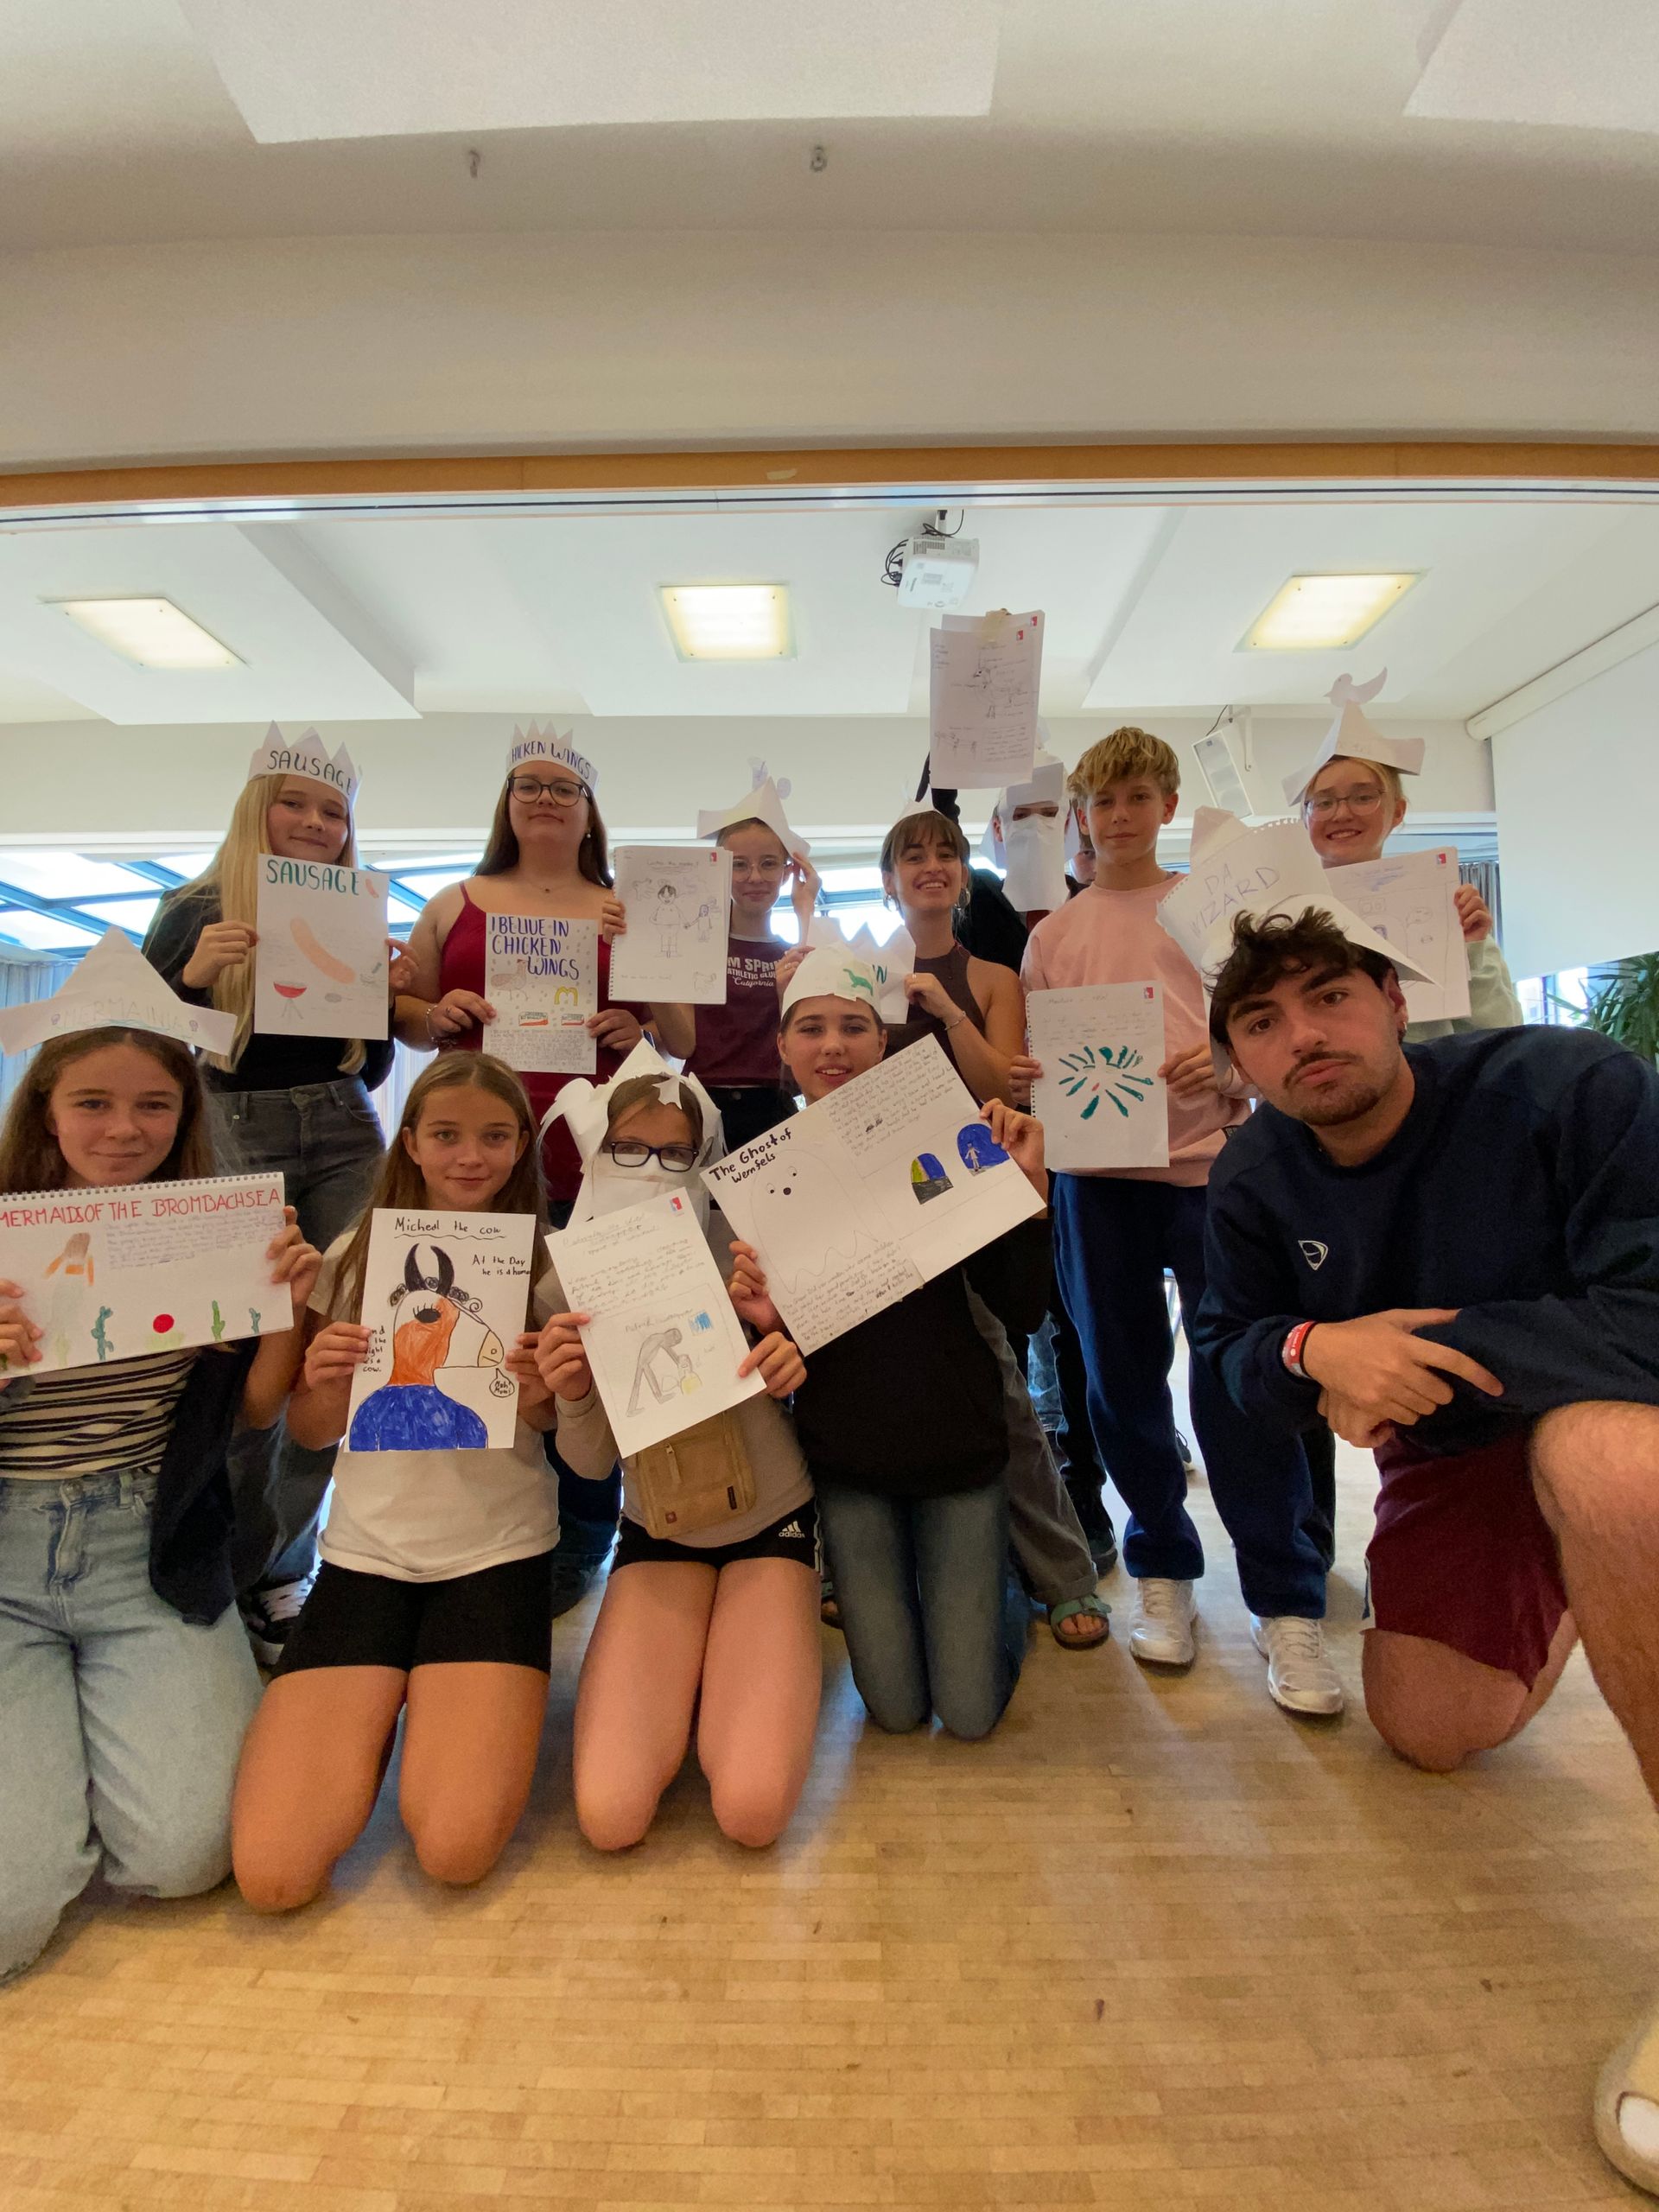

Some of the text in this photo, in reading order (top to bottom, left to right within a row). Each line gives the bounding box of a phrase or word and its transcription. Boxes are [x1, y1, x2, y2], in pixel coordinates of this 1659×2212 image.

[512, 741, 592, 779] HICKEN WINGS
[267, 750, 353, 796] SAUSAGE
[265, 859, 359, 896] SAUSAGE
[1205, 864, 1233, 895] DA
[1190, 867, 1281, 939] WIZARD
[491, 917, 495, 931] I
[553, 919, 569, 938] IN
[492, 934, 562, 957] CHICKEN
[527, 956, 580, 981] WINGS
[727, 967, 759, 980] ATHLETIC
[733, 976, 774, 988] California
[709, 1128, 791, 1181] The Ghost of
[731, 1153, 776, 1184] Wernfels
[0, 1188, 281, 1228] MERMAIDS OF THE BROMBACHSEA
[454, 1220, 468, 1232] the
[472, 1254, 525, 1267] At the Day
[371, 1325, 385, 1335] nd
[368, 1346, 383, 1357] ight
